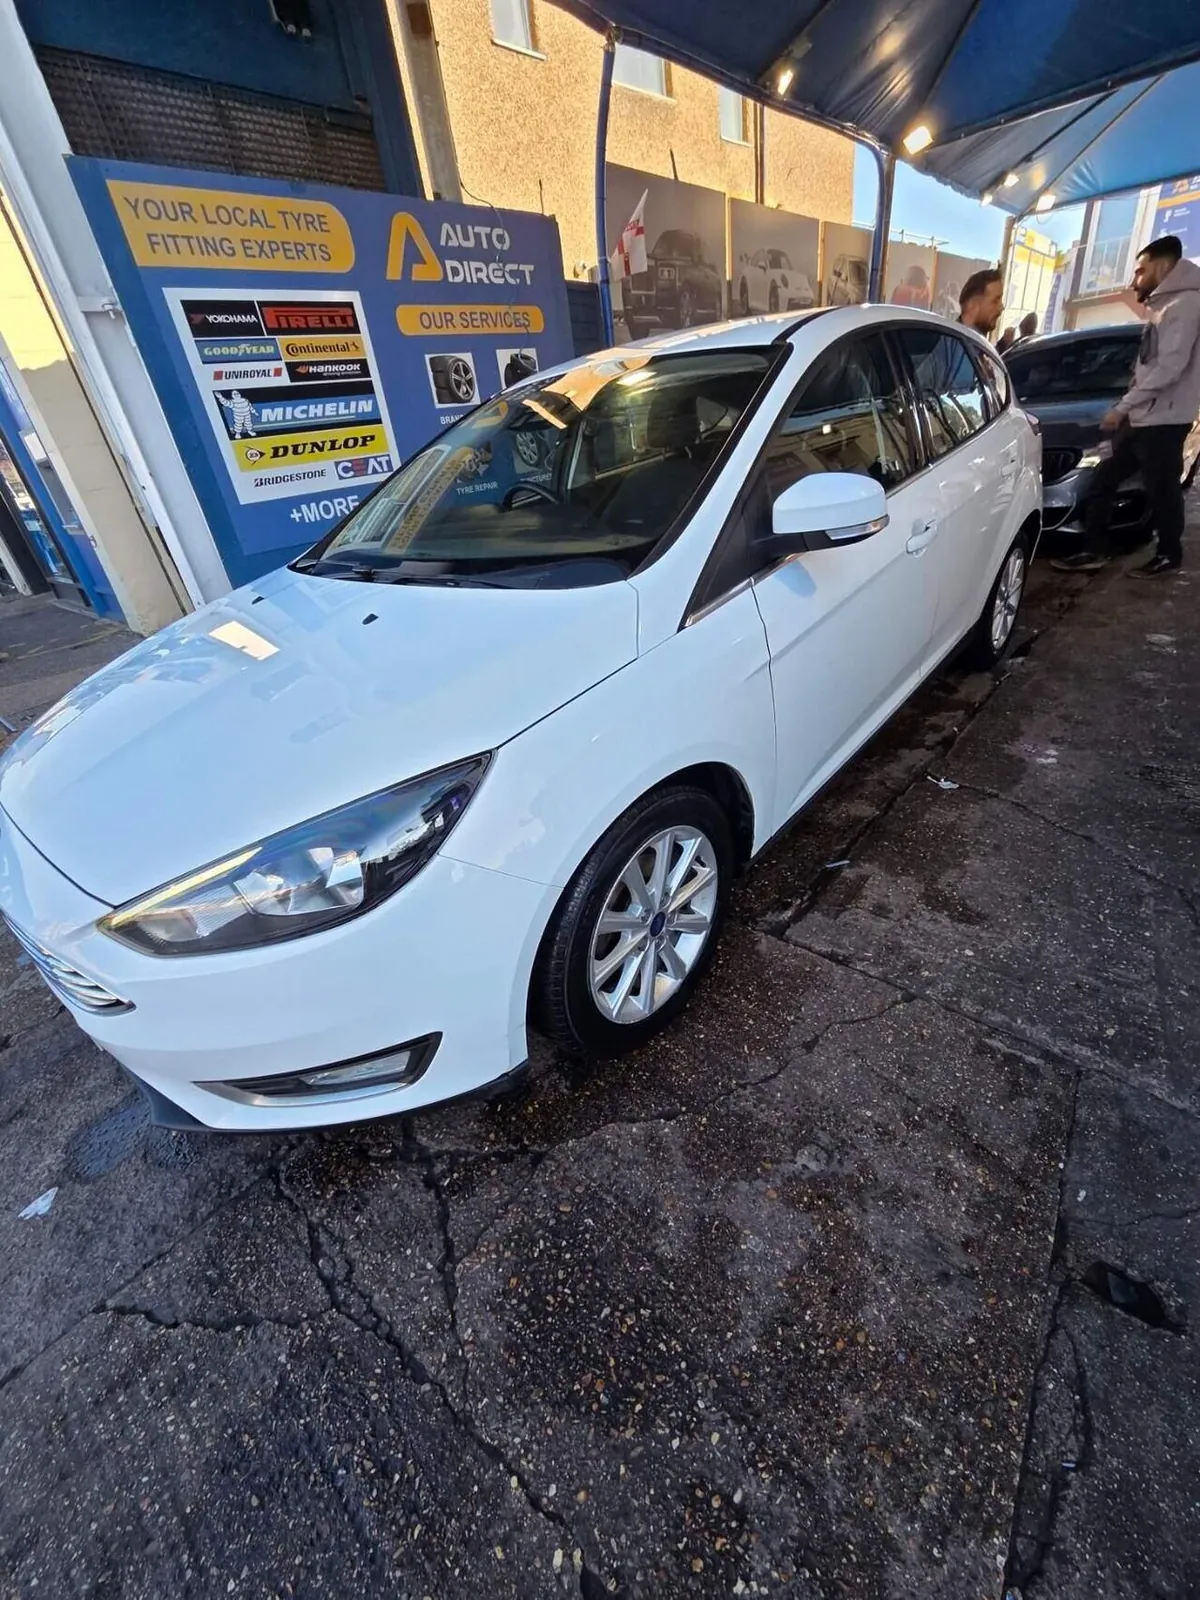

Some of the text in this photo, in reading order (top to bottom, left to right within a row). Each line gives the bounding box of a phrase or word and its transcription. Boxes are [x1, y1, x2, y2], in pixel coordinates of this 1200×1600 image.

[124, 197, 331, 233] YOUR LOCAL TYRE
[146, 233, 332, 262] FITTING EXPERTS
[440, 223, 511, 250] AUTO
[445, 259, 535, 285] DIRECT
[205, 314, 258, 324] YOKOHAMA
[261, 306, 354, 328] PIRELLI
[419, 311, 531, 330] OUR SERVICES
[204, 343, 275, 357] GOODYEAR
[285, 342, 350, 357] Continental
[224, 368, 273, 380] UNIROYAL
[261, 400, 373, 422] MICHELIN
[269, 434, 376, 459] DUNLOP
[336, 456, 391, 478] CEAT
[253, 469, 327, 488] BRIDGESTONE
[456, 481, 500, 496] TYRE REPAIR
